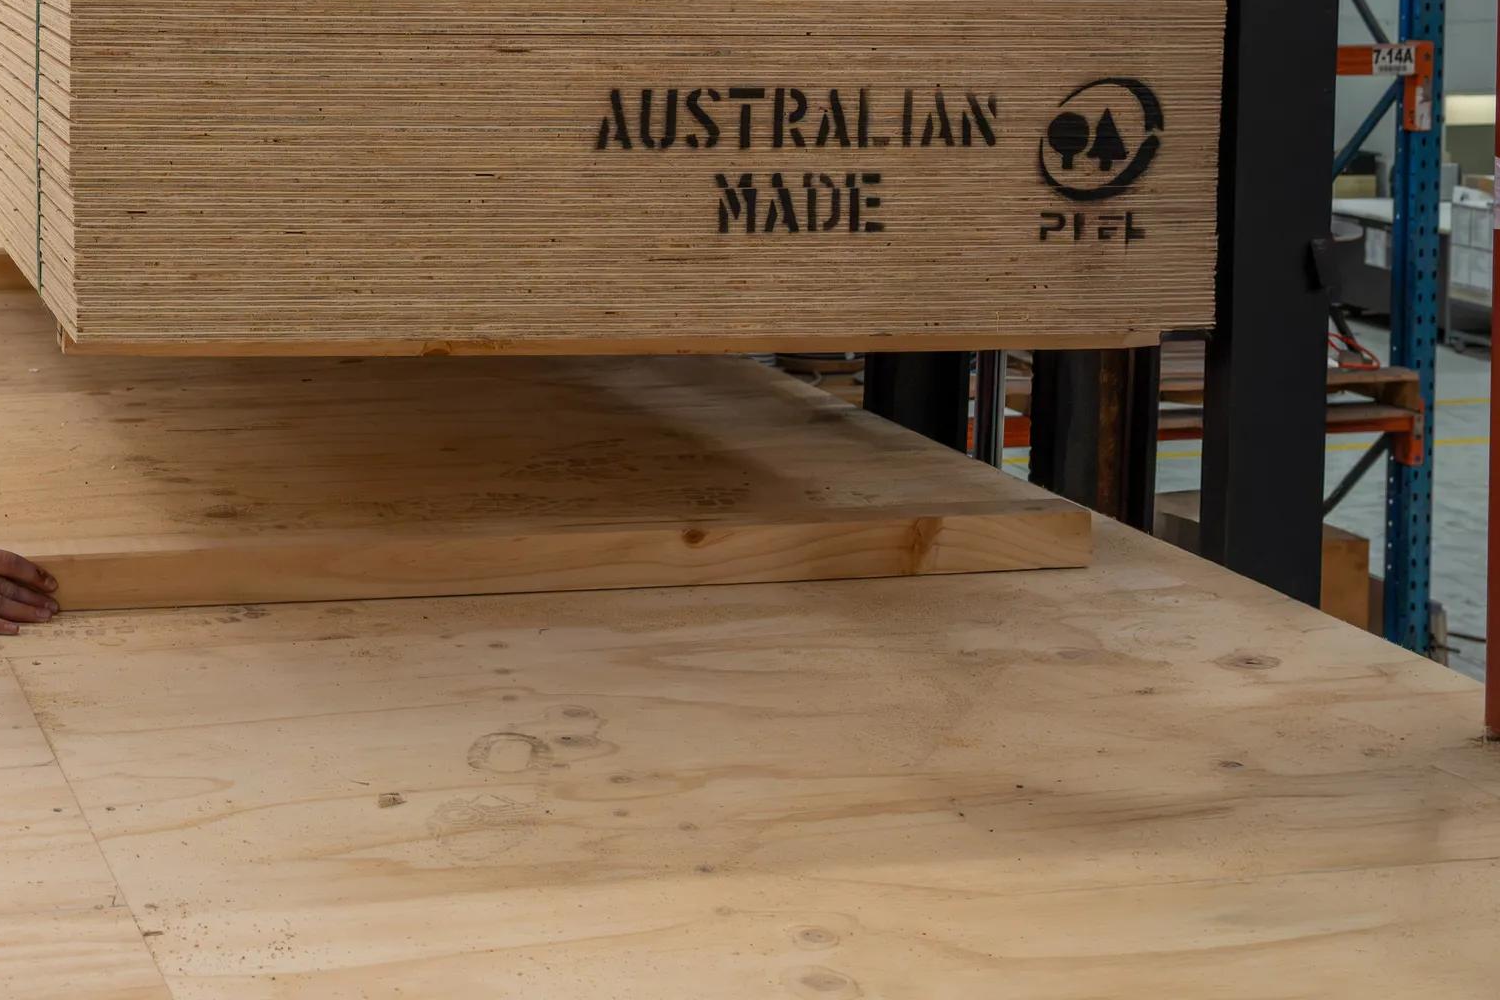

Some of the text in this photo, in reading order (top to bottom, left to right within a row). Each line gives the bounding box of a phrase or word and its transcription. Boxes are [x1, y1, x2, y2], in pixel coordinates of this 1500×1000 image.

[1373, 48, 1413, 65] 7-14A
[596, 87, 997, 150] AUSTRALIAN
[714, 172, 885, 233] MADE
